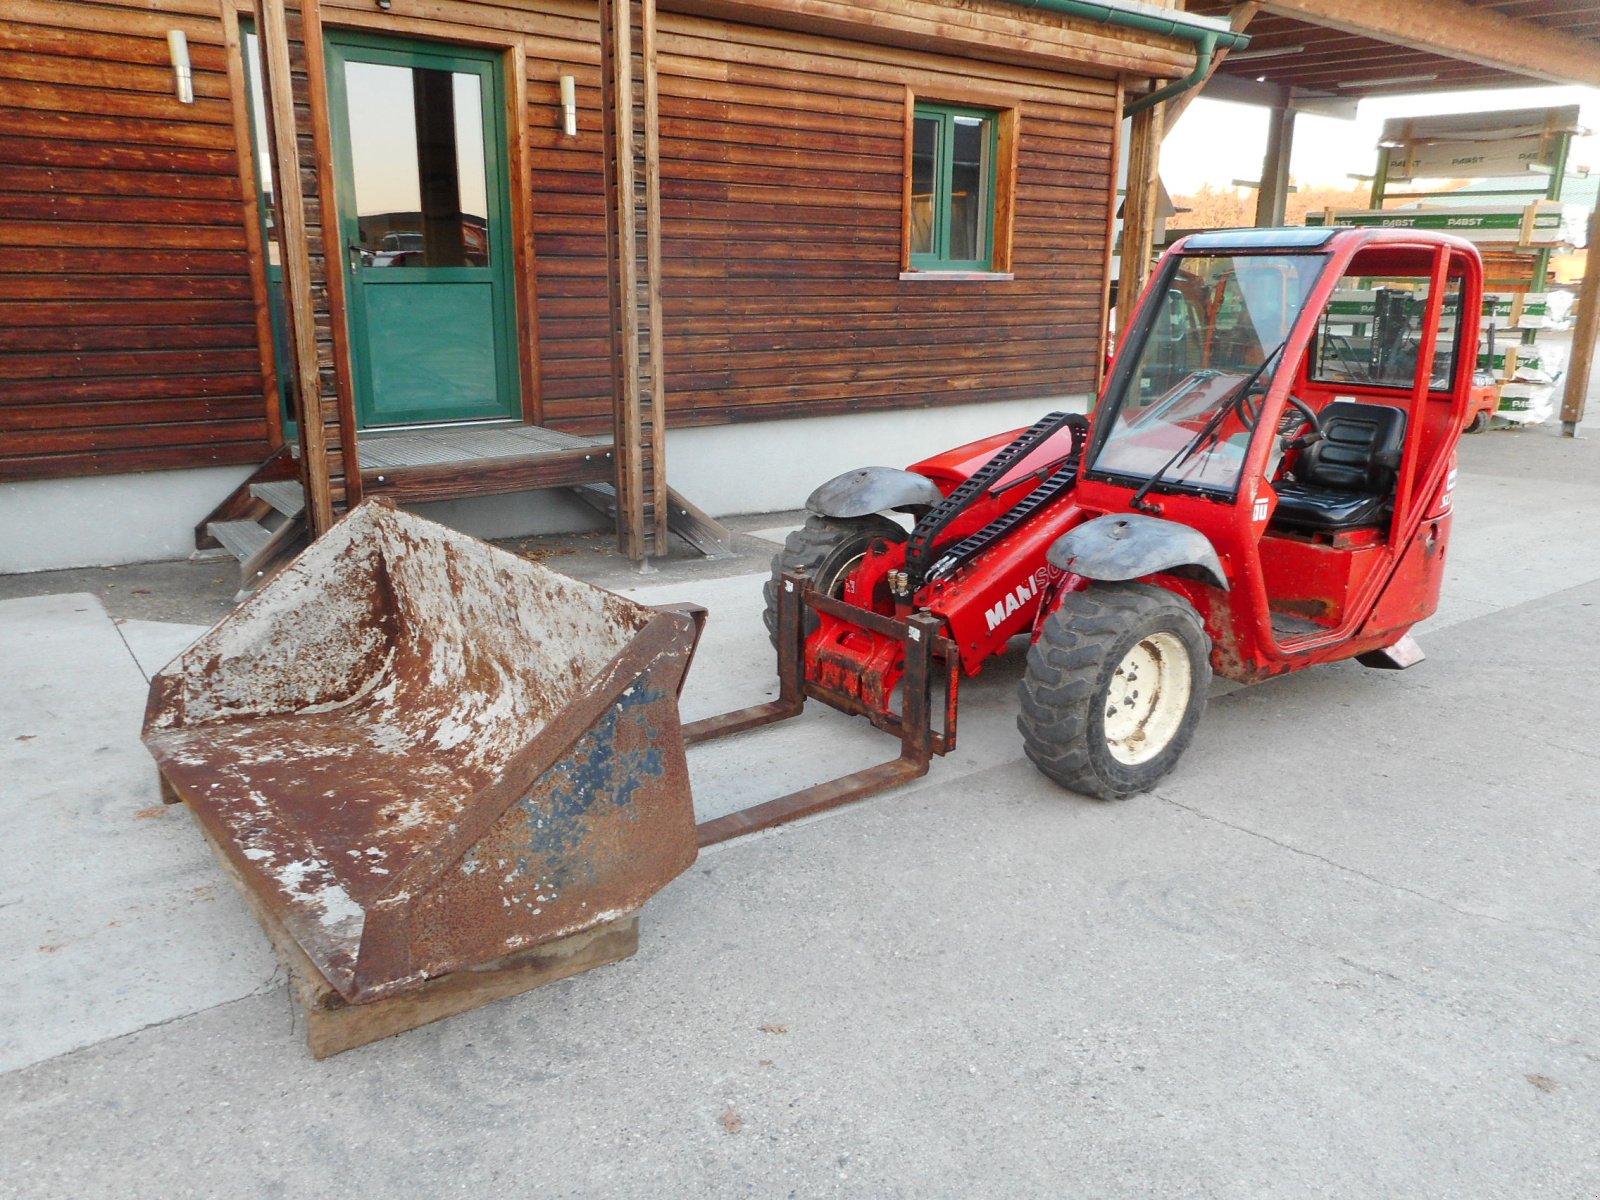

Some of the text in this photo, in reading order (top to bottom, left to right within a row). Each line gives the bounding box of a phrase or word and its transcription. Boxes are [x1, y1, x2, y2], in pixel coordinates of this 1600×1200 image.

[1451, 156, 1486, 165] PABST
[1382, 219, 1415, 227] PABST
[1447, 218, 1484, 226] PABST
